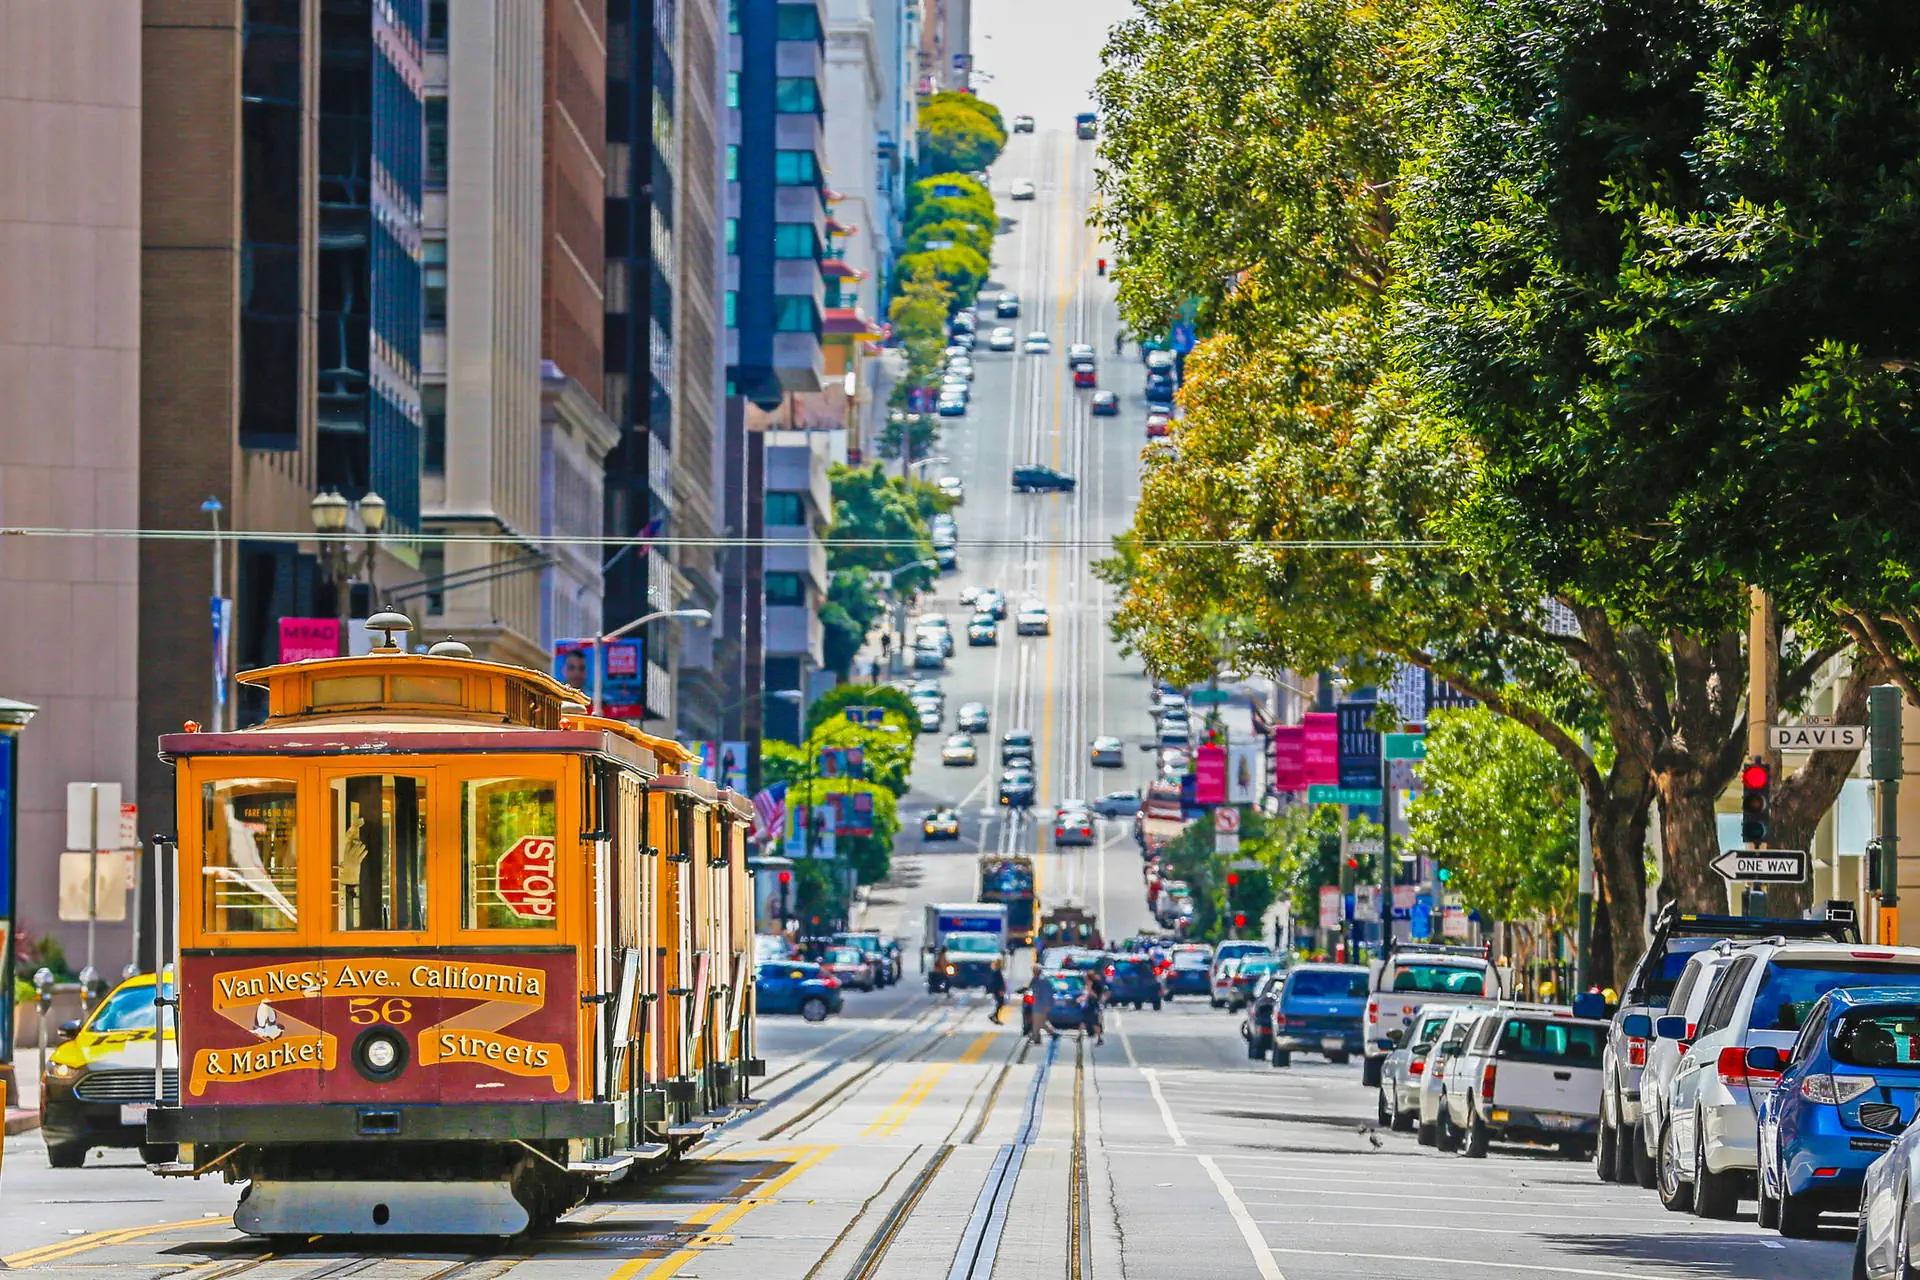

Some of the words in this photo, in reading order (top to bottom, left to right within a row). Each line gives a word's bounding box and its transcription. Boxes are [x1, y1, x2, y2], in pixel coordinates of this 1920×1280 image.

[1778, 730, 1854, 745] DAVIS
[244, 808, 261, 817] FARE
[522, 840, 555, 915] STOP
[1737, 859, 1763, 872] ONE
[1767, 859, 1795, 872] WAY
[219, 976, 264, 1000] Van
[265, 967, 328, 994] Ness
[409, 965, 540, 996] California
[349, 997, 412, 1025] 56
[206, 1052, 226, 1075] &
[230, 1039, 326, 1075] Market
[439, 1033, 550, 1068] Streets
